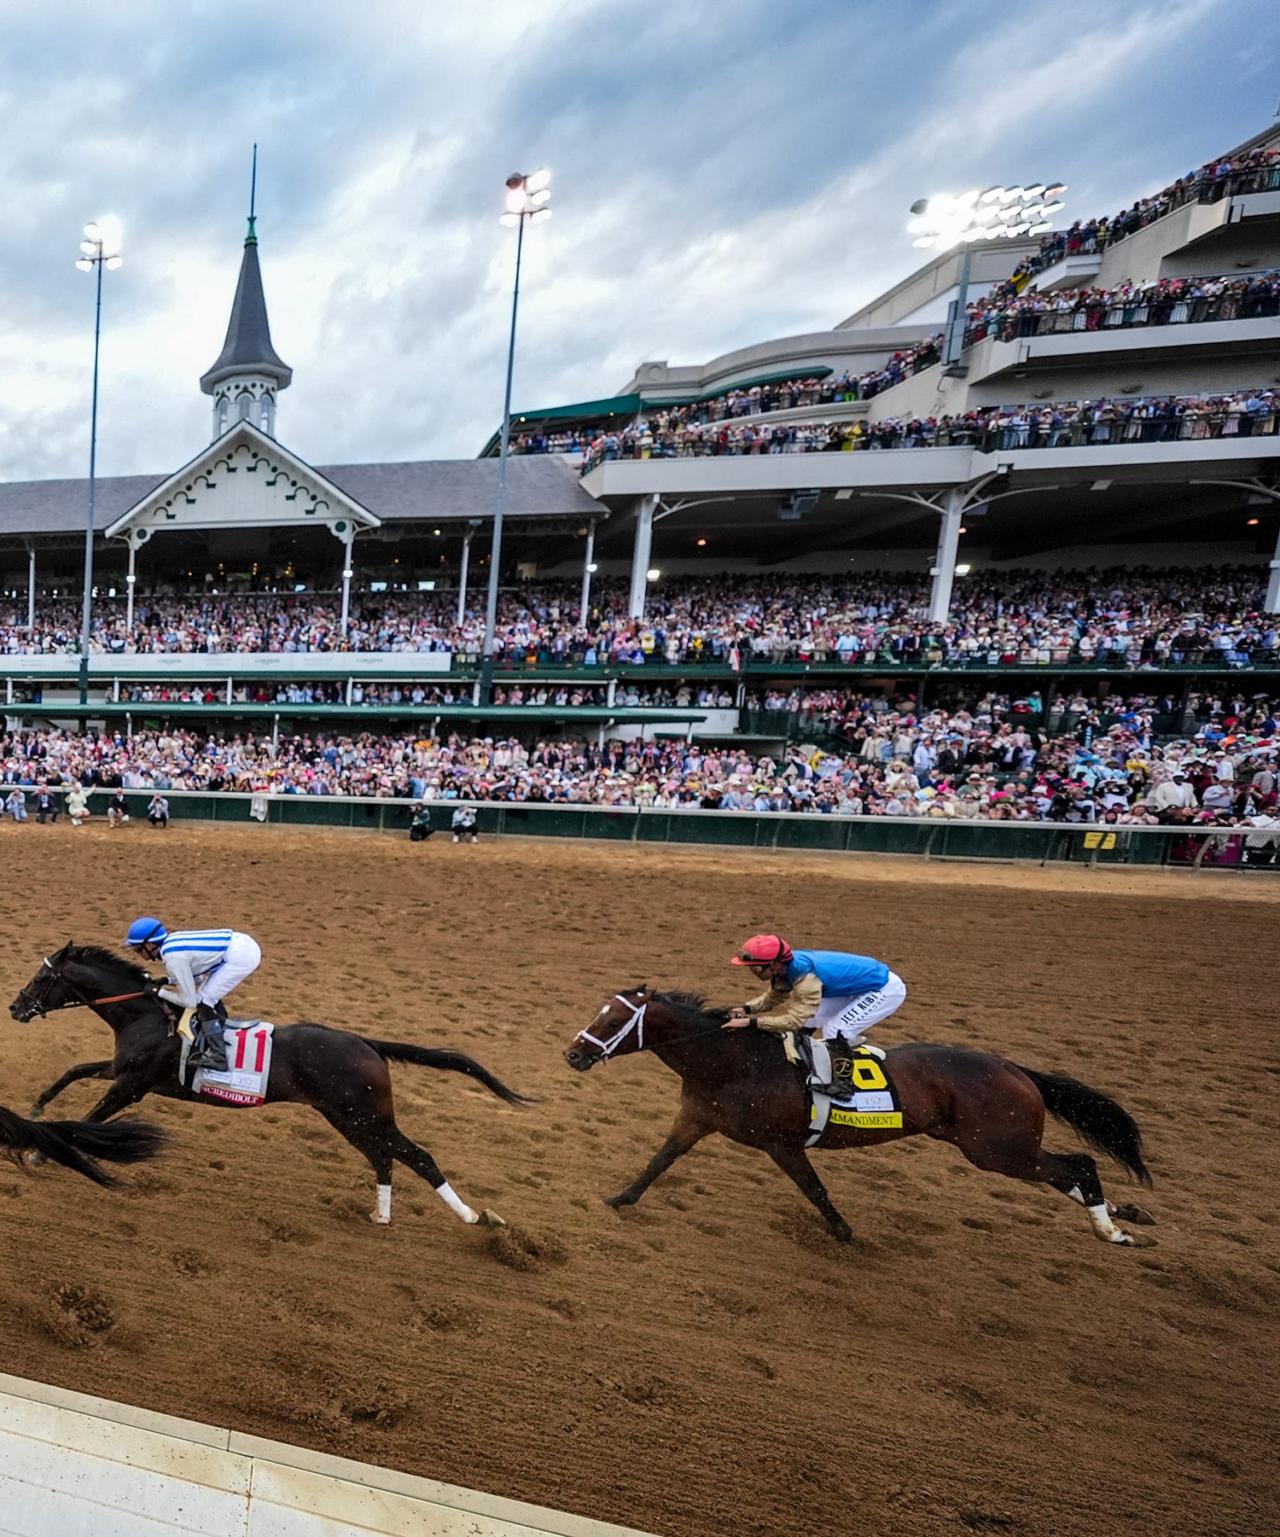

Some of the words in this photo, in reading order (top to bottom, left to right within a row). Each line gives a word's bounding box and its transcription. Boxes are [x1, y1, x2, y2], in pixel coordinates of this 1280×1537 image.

[840, 1007, 860, 1025] JEFF
[234, 1028, 267, 1073] 11
[830, 1111, 895, 1126] MMANDMENT
